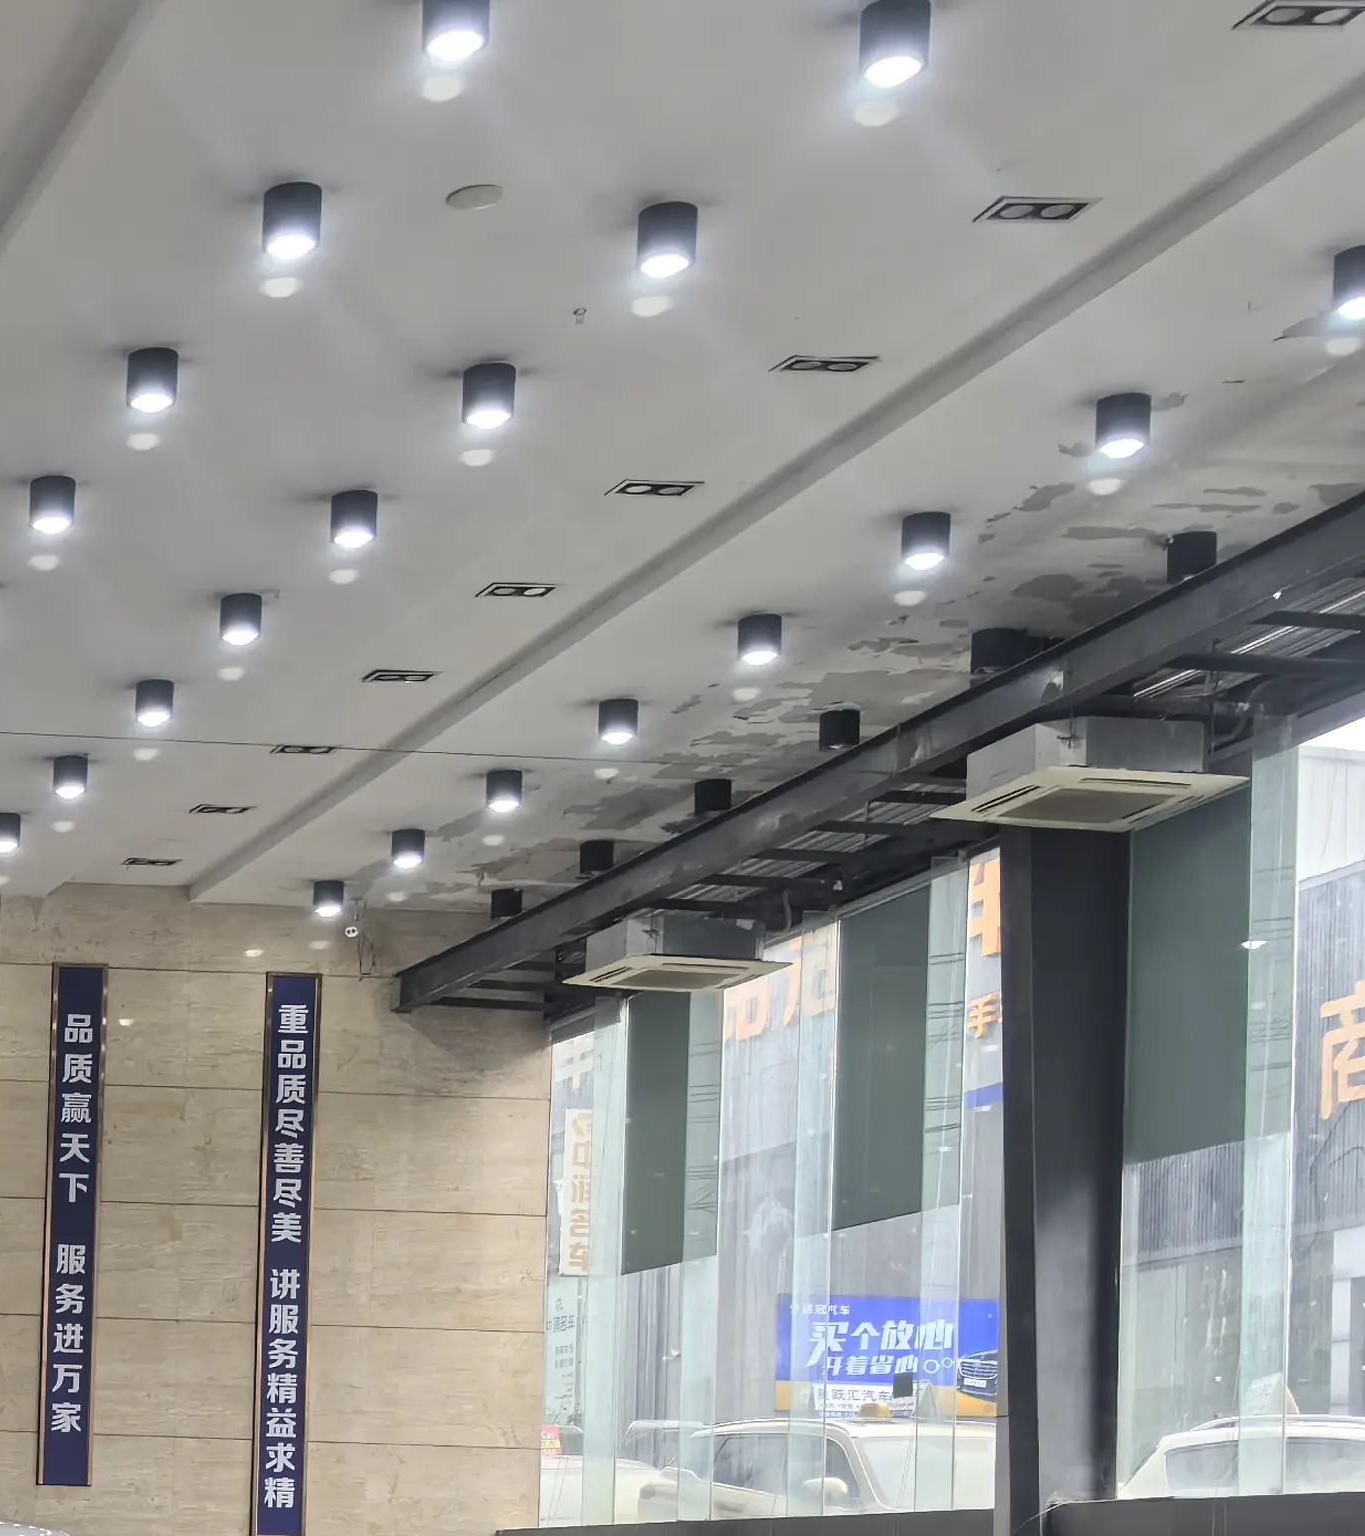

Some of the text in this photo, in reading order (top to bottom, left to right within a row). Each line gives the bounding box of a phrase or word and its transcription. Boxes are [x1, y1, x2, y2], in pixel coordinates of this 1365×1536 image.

[51, 1013, 94, 1433] 品质赢天下 服务进万家
[264, 1004, 309, 1509] 重品质尽善尽美 讲服务精益求精
[805, 1319, 955, 1368] 买个放心
[822, 1354, 918, 1377] 开着省心
